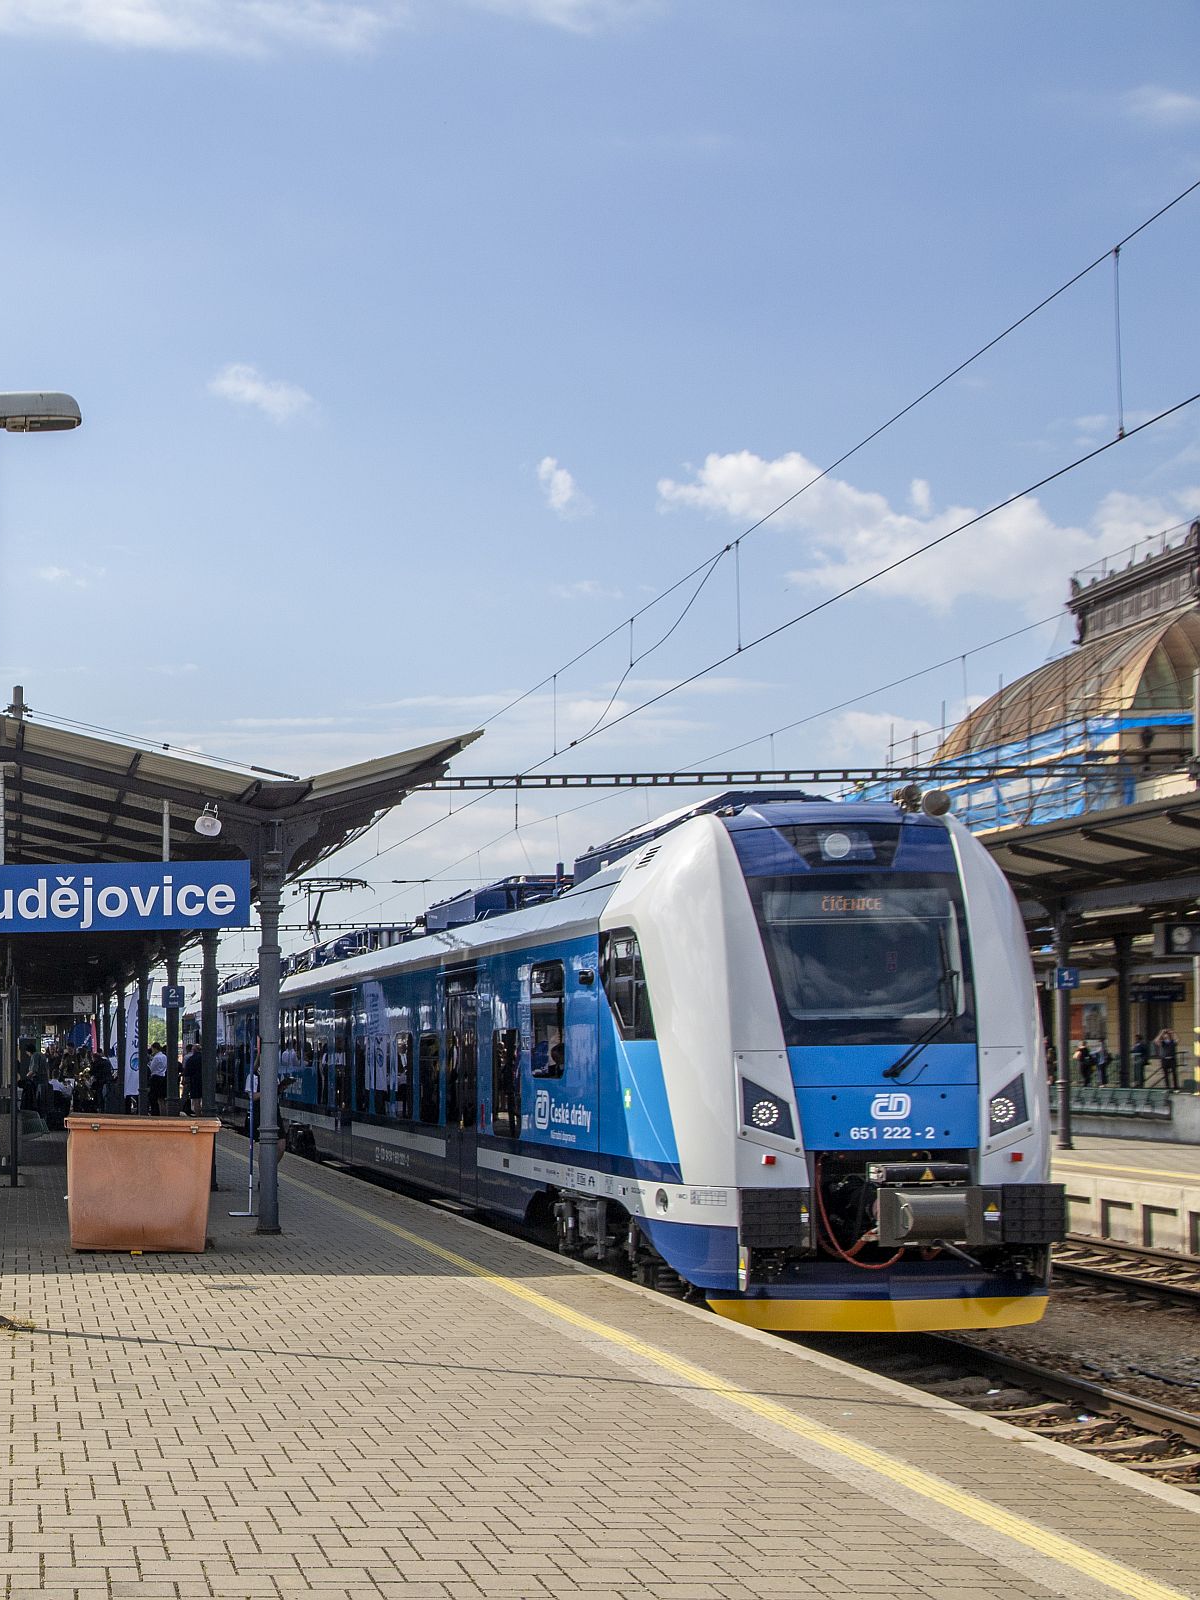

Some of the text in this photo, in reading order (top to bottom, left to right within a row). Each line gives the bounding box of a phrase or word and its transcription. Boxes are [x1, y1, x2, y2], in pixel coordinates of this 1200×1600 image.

[169, 988, 179, 998] 2.
[551, 1098, 569, 1124] České
[571, 1103, 592, 1133] dráhy
[850, 1127, 878, 1140] 651
[883, 1126, 912, 1139] 222
[925, 1126, 935, 1139] 2
